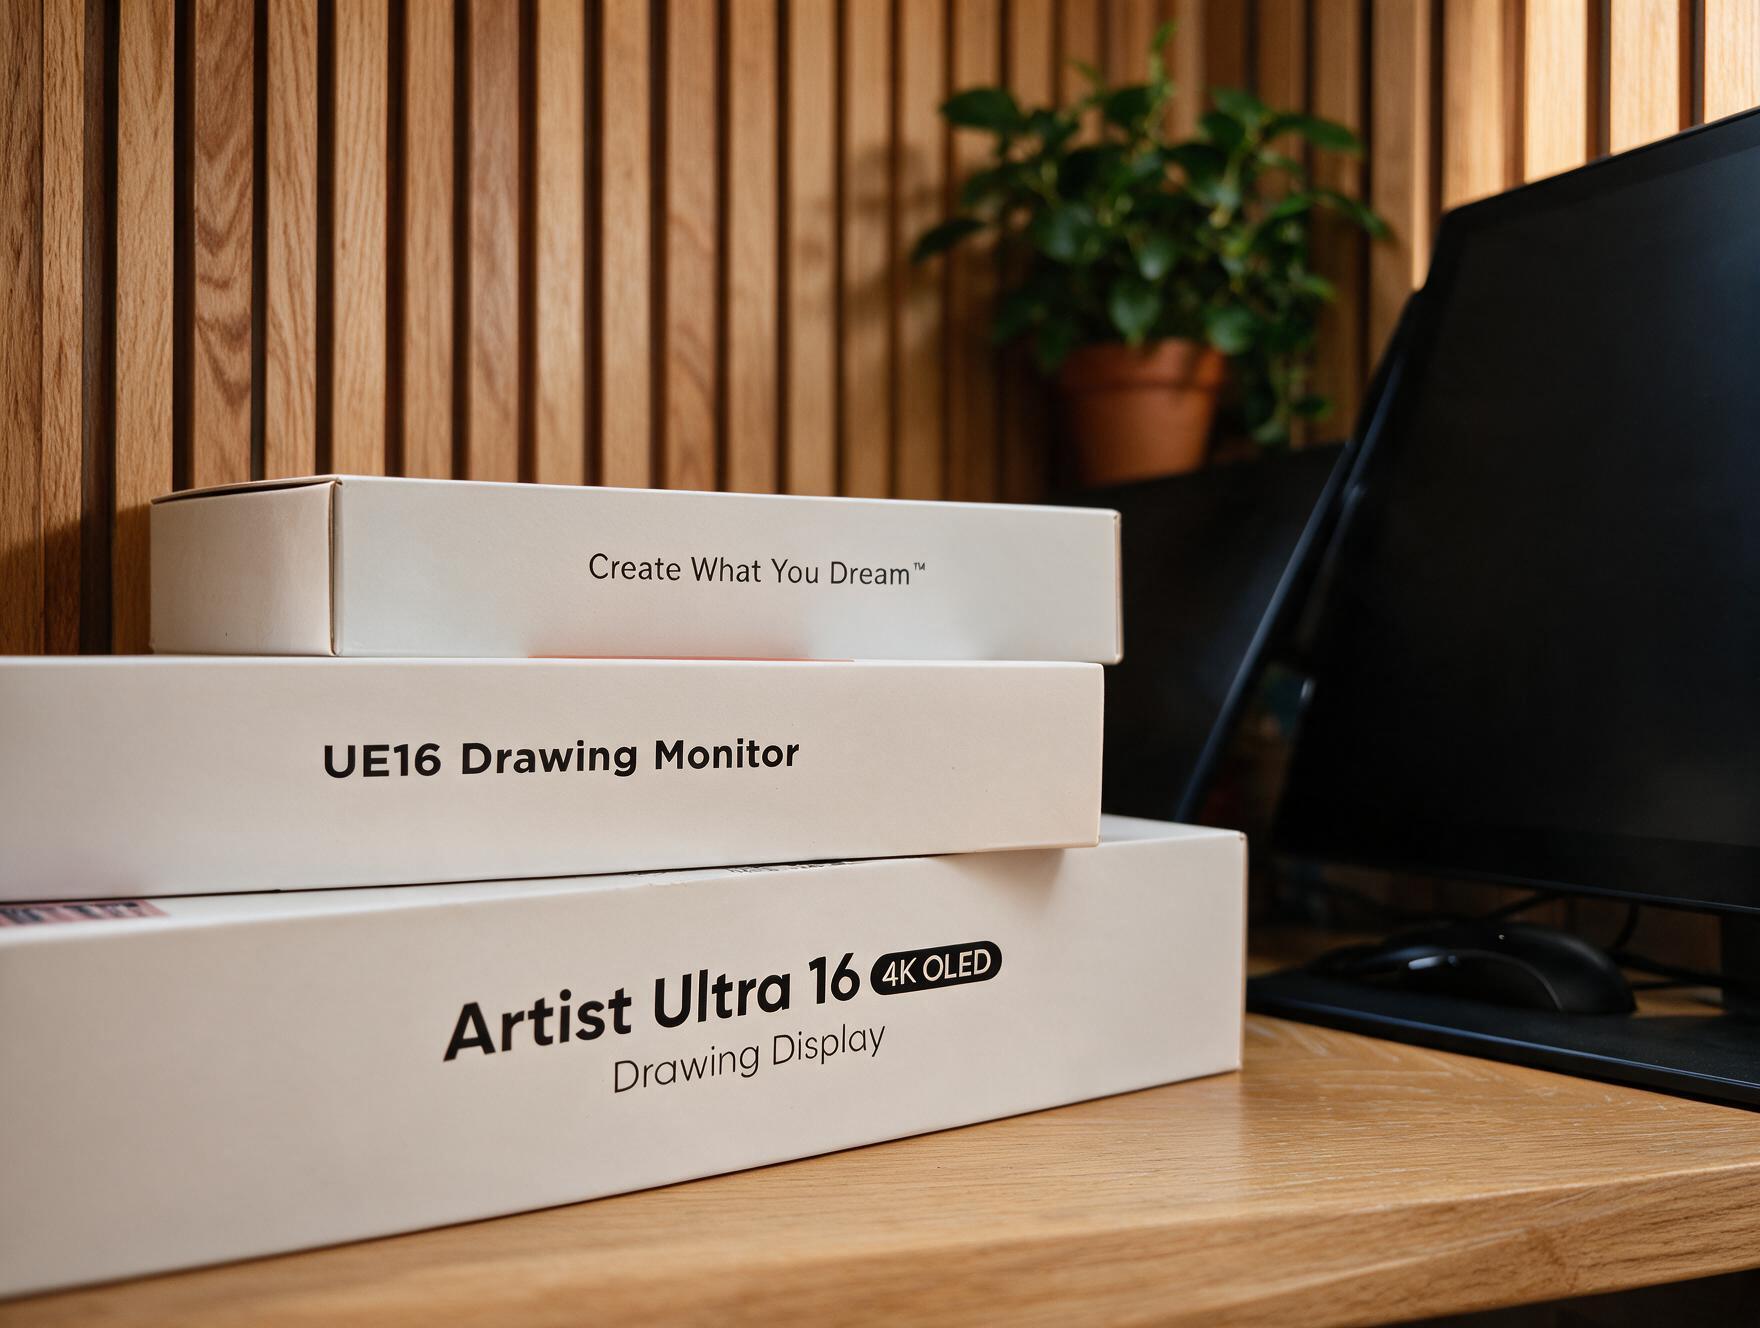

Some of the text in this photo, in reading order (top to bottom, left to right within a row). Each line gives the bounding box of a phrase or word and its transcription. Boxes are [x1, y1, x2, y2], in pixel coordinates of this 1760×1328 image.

[588, 552, 682, 582] Create
[690, 556, 762, 583] What
[770, 558, 819, 584] You
[324, 737, 800, 779] UE16 Drawing Monitor
[443, 948, 992, 1063] Artist Ultra 16 4K OLED
[614, 1023, 886, 1094] Drawing Display
